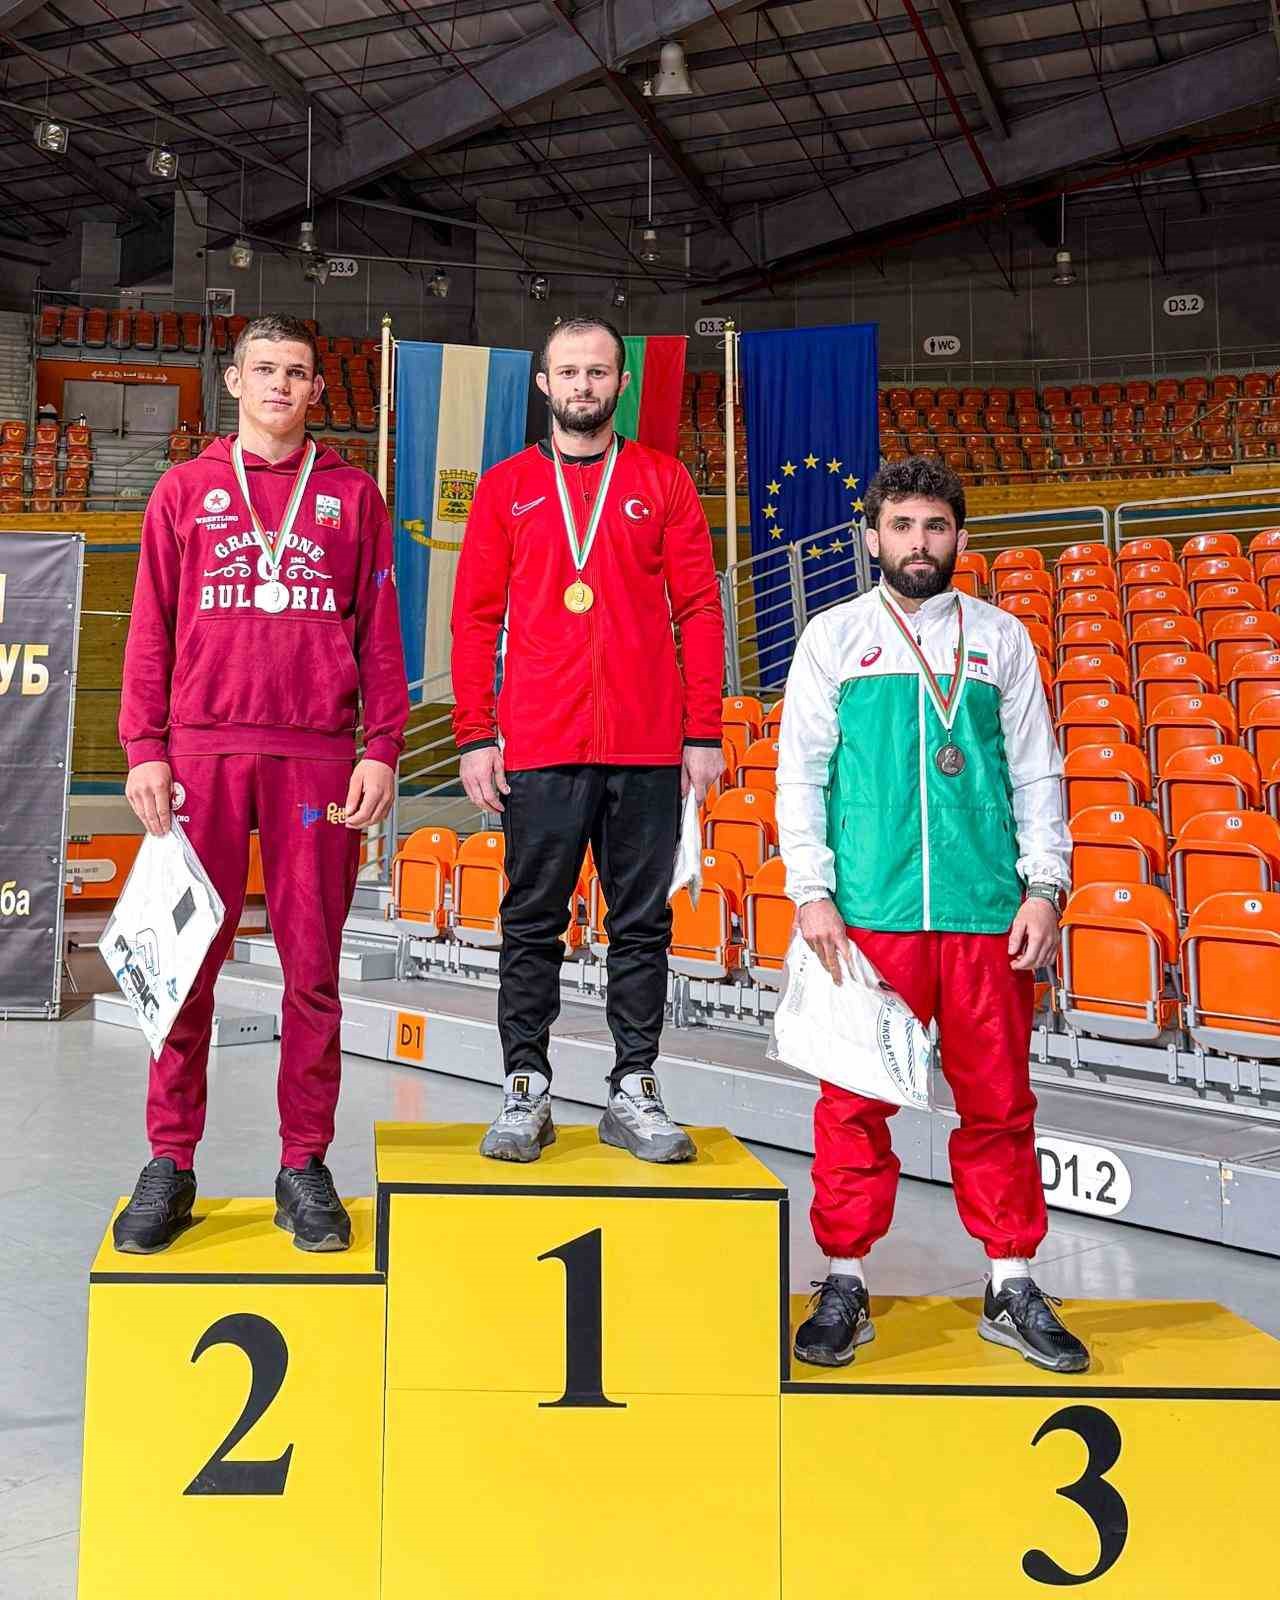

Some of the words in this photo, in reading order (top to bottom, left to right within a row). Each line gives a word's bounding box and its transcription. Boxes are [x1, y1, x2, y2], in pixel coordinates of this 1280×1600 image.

[329, 262, 354, 273] D3.4
[1168, 298, 1200, 312] D3.2
[937, 339, 956, 350] WC
[195, 515, 239, 525] WRESTLING
[206, 522, 228, 531] TEAM
[1229, 818, 1240, 827] 10
[1118, 891, 1128, 900] 10
[1250, 902, 1257, 911] 9
[401, 1024, 421, 1049] D1
[1036, 1147, 1117, 1205] D1.2
[536, 1227, 628, 1409] 1
[182, 1312, 295, 1496] 2
[1021, 1404, 1129, 1586] 3
